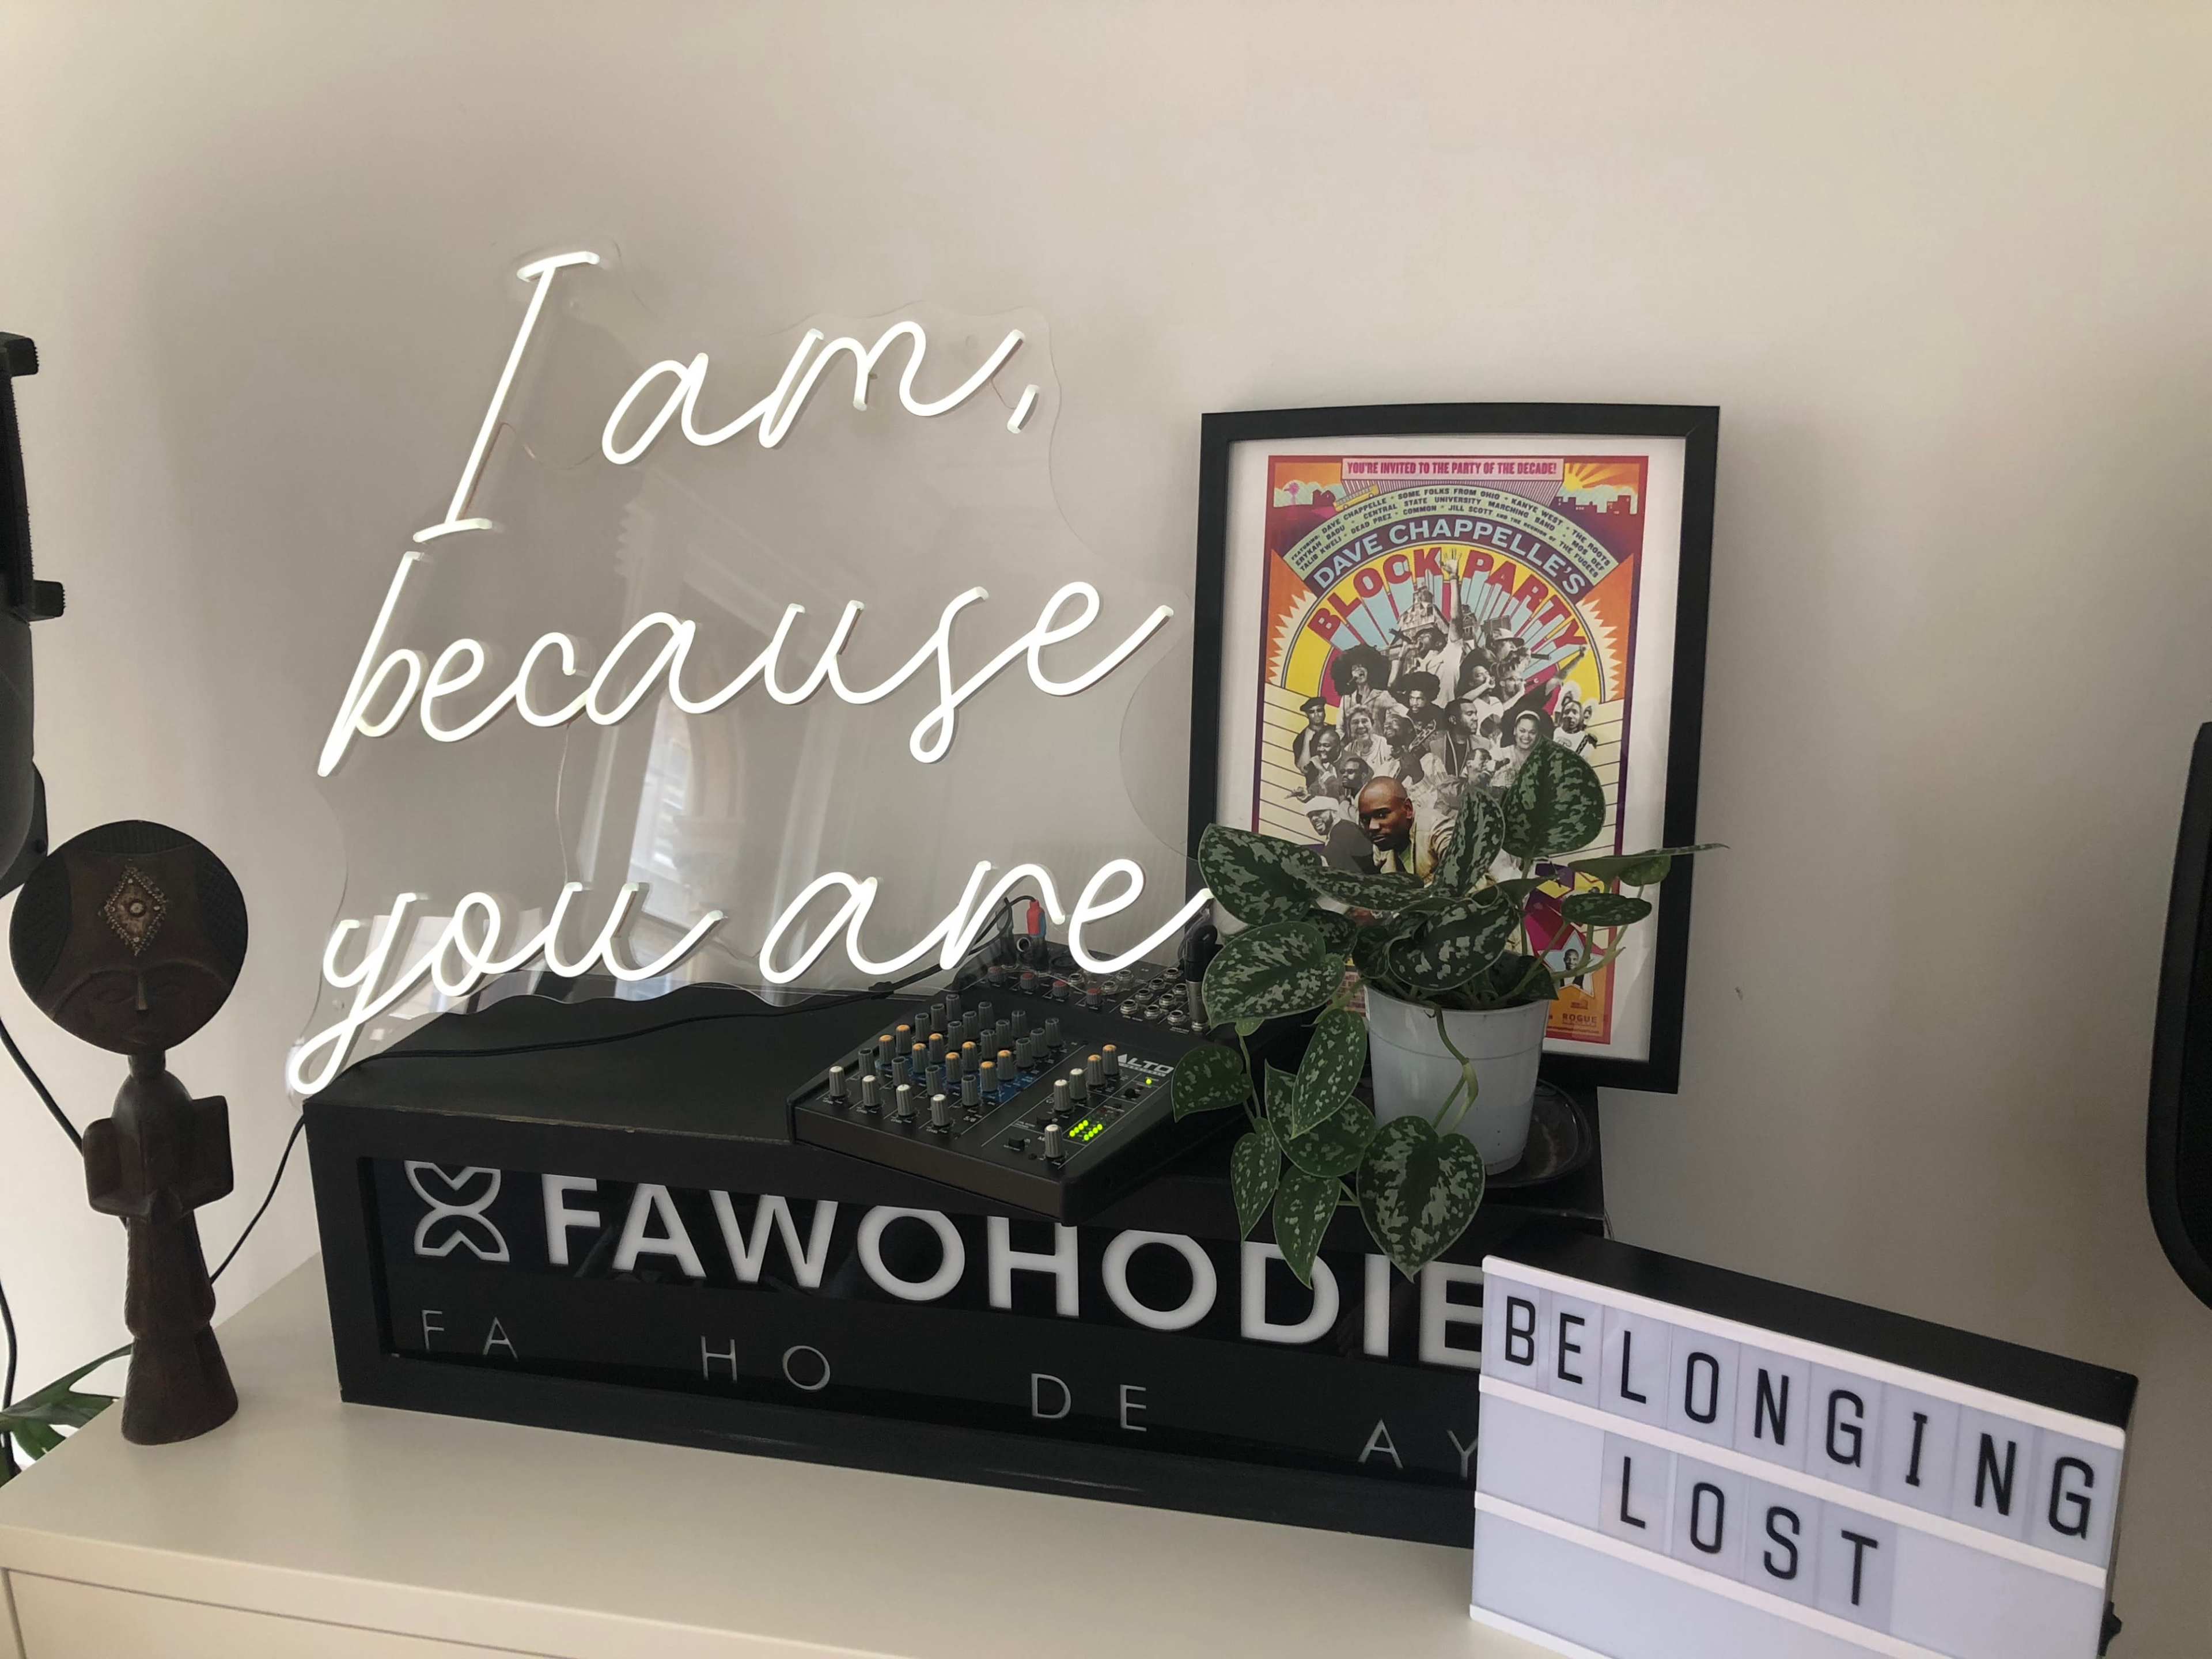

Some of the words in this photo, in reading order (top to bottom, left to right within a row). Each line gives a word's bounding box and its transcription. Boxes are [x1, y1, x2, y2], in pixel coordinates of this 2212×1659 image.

[414, 251, 600, 542] I
[602, 321, 1040, 464] am,
[1347, 462, 1378, 474] YOU'RE
[1380, 462, 1416, 474] INVITED
[1419, 462, 1430, 474] TO
[1433, 462, 1449, 474] THE
[1451, 462, 1481, 474] PARTY
[1483, 462, 1495, 474] OF
[1498, 462, 1515, 475] THE
[1517, 463, 1556, 475] DECADE!
[1296, 541, 1322, 566] ERYKAH
[1326, 525, 1346, 540] BADU
[1363, 503, 1398, 520] CENTRAL
[1404, 498, 1427, 507] STATE
[1434, 496, 1482, 505] UNIVERSITY
[1488, 500, 1530, 518] MARCHING
[1534, 517, 1555, 532] BAND
[1571, 540, 1588, 555] MOS
[1590, 557, 1605, 572] DEF
[1300, 554, 1320, 571] TALIB
[1320, 537, 1342, 554] KWELI
[1351, 521, 1370, 535] DEAD
[1373, 513, 1392, 525] PREZ
[1403, 505, 1437, 516] COMMON
[1468, 506, 1493, 516] SCOTT
[1559, 541, 1573, 555] THE
[1573, 553, 1599, 578] FUGEES
[1313, 533, 1383, 590] DAVE
[1389, 518, 1586, 596] CHAPPELLE'S
[1321, 519, 1341, 534] DAVE
[1343, 497, 1387, 521] CHAPPELLE
[1397, 490, 1421, 500] SOME
[1424, 488, 1449, 496] FOLKS
[1453, 488, 1476, 496] FROM
[1480, 490, 1500, 500] OHIO
[1511, 498, 1539, 513] KANYE
[1541, 510, 1563, 527] WEST
[1571, 529, 1588, 544] THE
[1587, 543, 1611, 567] ROOTS
[1306, 546, 1442, 638] BLOCK
[1462, 549, 1588, 649] PARTY
[318, 550, 1173, 777] because
[287, 880, 725, 1096] you
[759, 858, 1214, 984] are
[1563, 1013, 1597, 1023] ROGUE
[1118, 1054, 1175, 1074] ALTO
[541, 1173, 1484, 1370] FAWOHODIE
[1505, 1295, 2095, 1540] BELONGING
[1620, 1456, 1878, 1606] LOST
